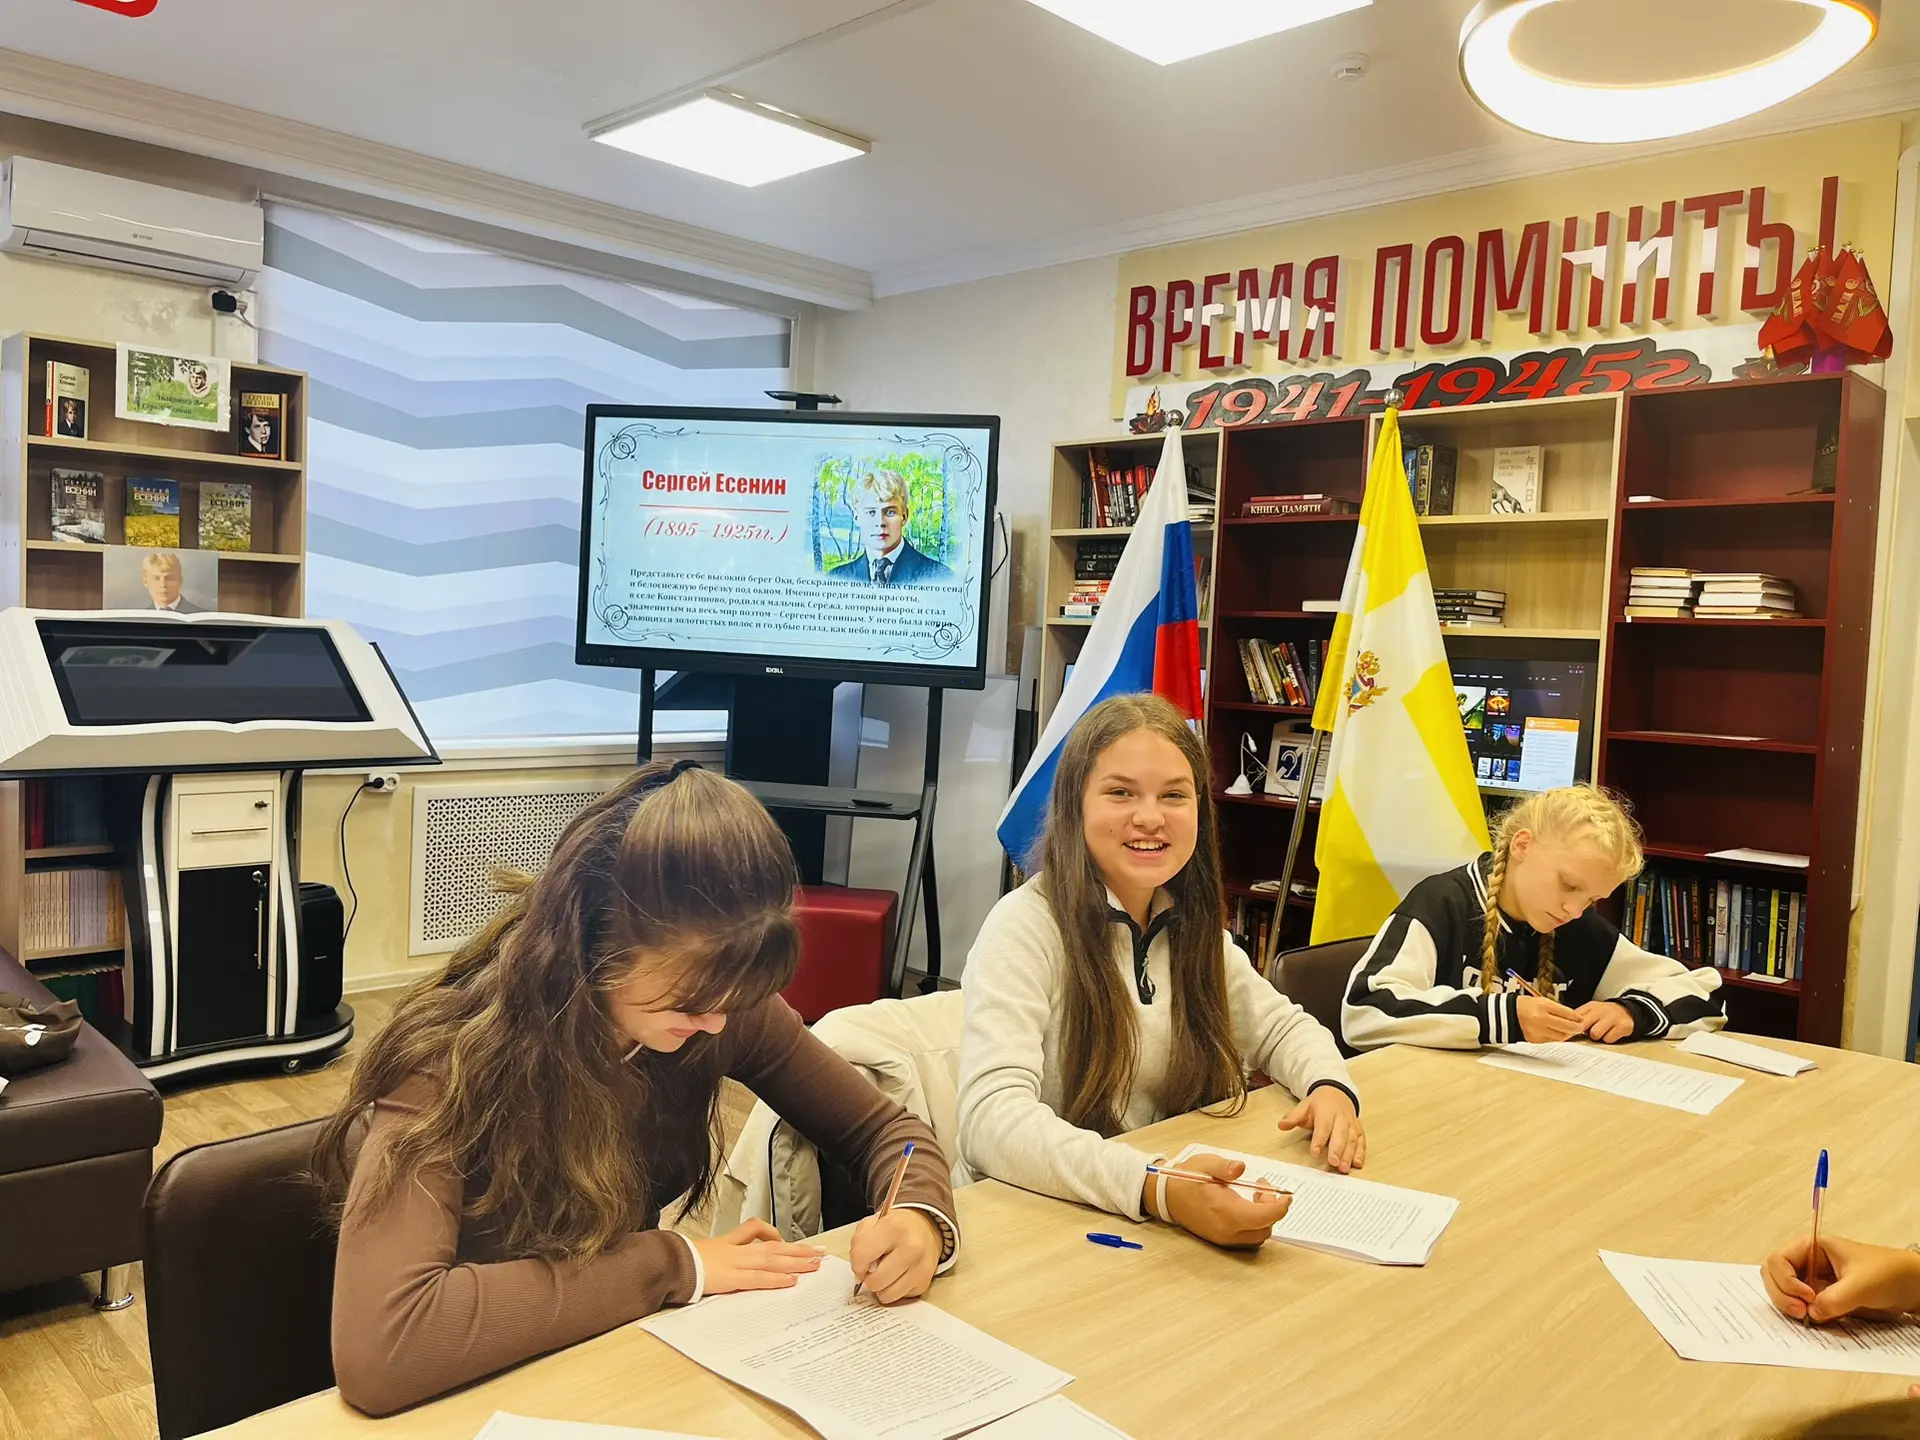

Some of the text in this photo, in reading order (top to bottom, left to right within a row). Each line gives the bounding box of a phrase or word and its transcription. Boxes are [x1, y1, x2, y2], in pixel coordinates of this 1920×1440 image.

[1126, 255, 1341, 378] ВРЕМЯ
[65, 486, 97, 497] ЕСЕНИН
[642, 470, 787, 495] Сергей Есенин
[135, 493, 170, 503] ЕСЕНИН
[1250, 504, 1322, 514] КНИГА ПАМЯТИ
[630, 568, 685, 579] Представьте
[686, 572, 706, 580] себе
[707, 573, 746, 582] высокий
[748, 574, 772, 585] берег
[774, 576, 795, 585] Оки,
[796, 577, 849, 588] бескрайнее
[850, 581, 874, 590] поле,
[876, 582, 901, 590] запах
[903, 584, 940, 592] свежего
[637, 580, 697, 592] белоснежную
[735, 587, 751, 595] под
[752, 588, 783, 596] окном.
[785, 587, 820, 597] Именно
[821, 591, 849, 600] среди
[851, 591, 877, 600] такой
[879, 594, 920, 603] красоты,
[628, 603, 684, 613] знаменитым
[719, 608, 738, 617] мир
[739, 610, 771, 618] поэтом
[779, 610, 816, 621] Сергеем
[817, 612, 866, 623] Есениным.
[868, 615, 876, 623] У
[876, 617, 897, 625] него
[898, 617, 923, 626] была
[657, 592, 727, 605] Константиново,
[728, 598, 766, 606] родился
[767, 600, 806, 608] мальчик
[844, 604, 885, 613] который
[886, 606, 916, 615] вырос
[925, 608, 946, 616] стал
[628, 615, 673, 623] вьющихся
[674, 617, 727, 627] золотистых
[728, 620, 754, 628] волос
[763, 621, 801, 632] голубые
[802, 624, 829, 633] глаза,
[830, 626, 847, 634] как
[848, 625, 870, 635] небо
[879, 628, 910, 637] ясный
